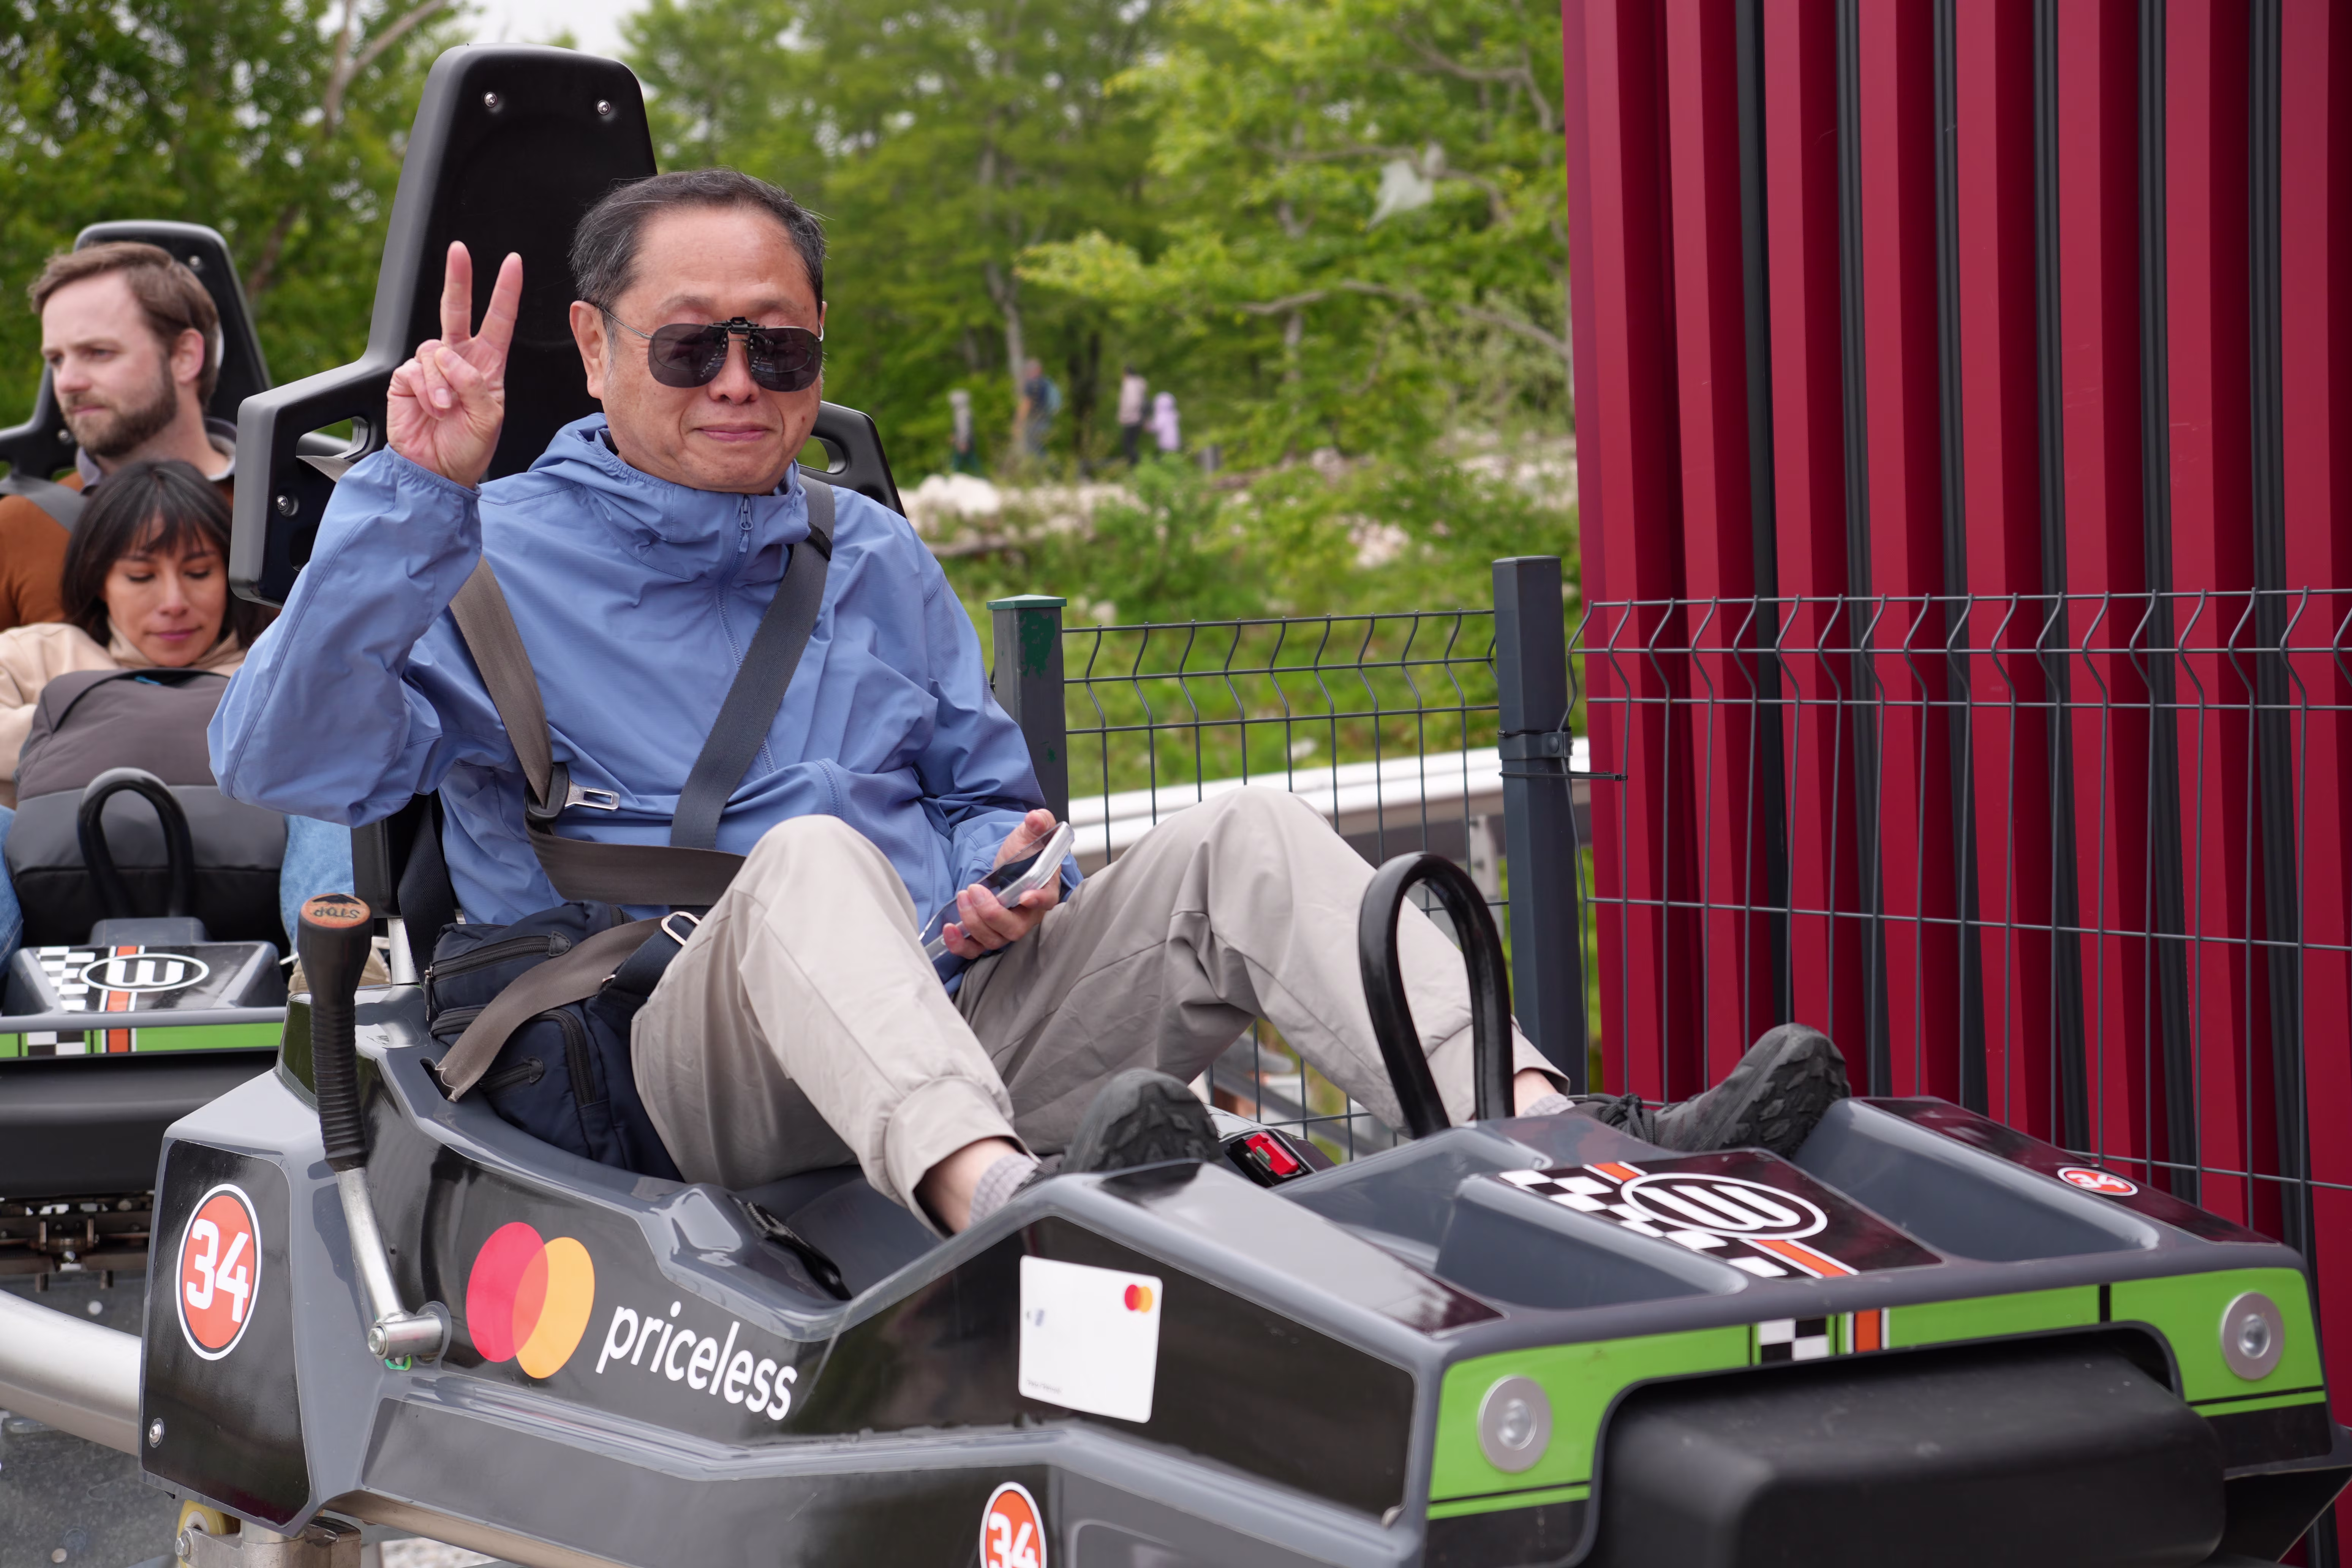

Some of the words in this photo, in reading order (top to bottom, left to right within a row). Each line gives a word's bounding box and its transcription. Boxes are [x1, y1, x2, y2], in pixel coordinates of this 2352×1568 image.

[2067, 1173, 2128, 1190] 34
[186, 1218, 249, 1323] 34
[595, 1301, 798, 1421] priceless
[988, 1511, 1038, 1568] 34
